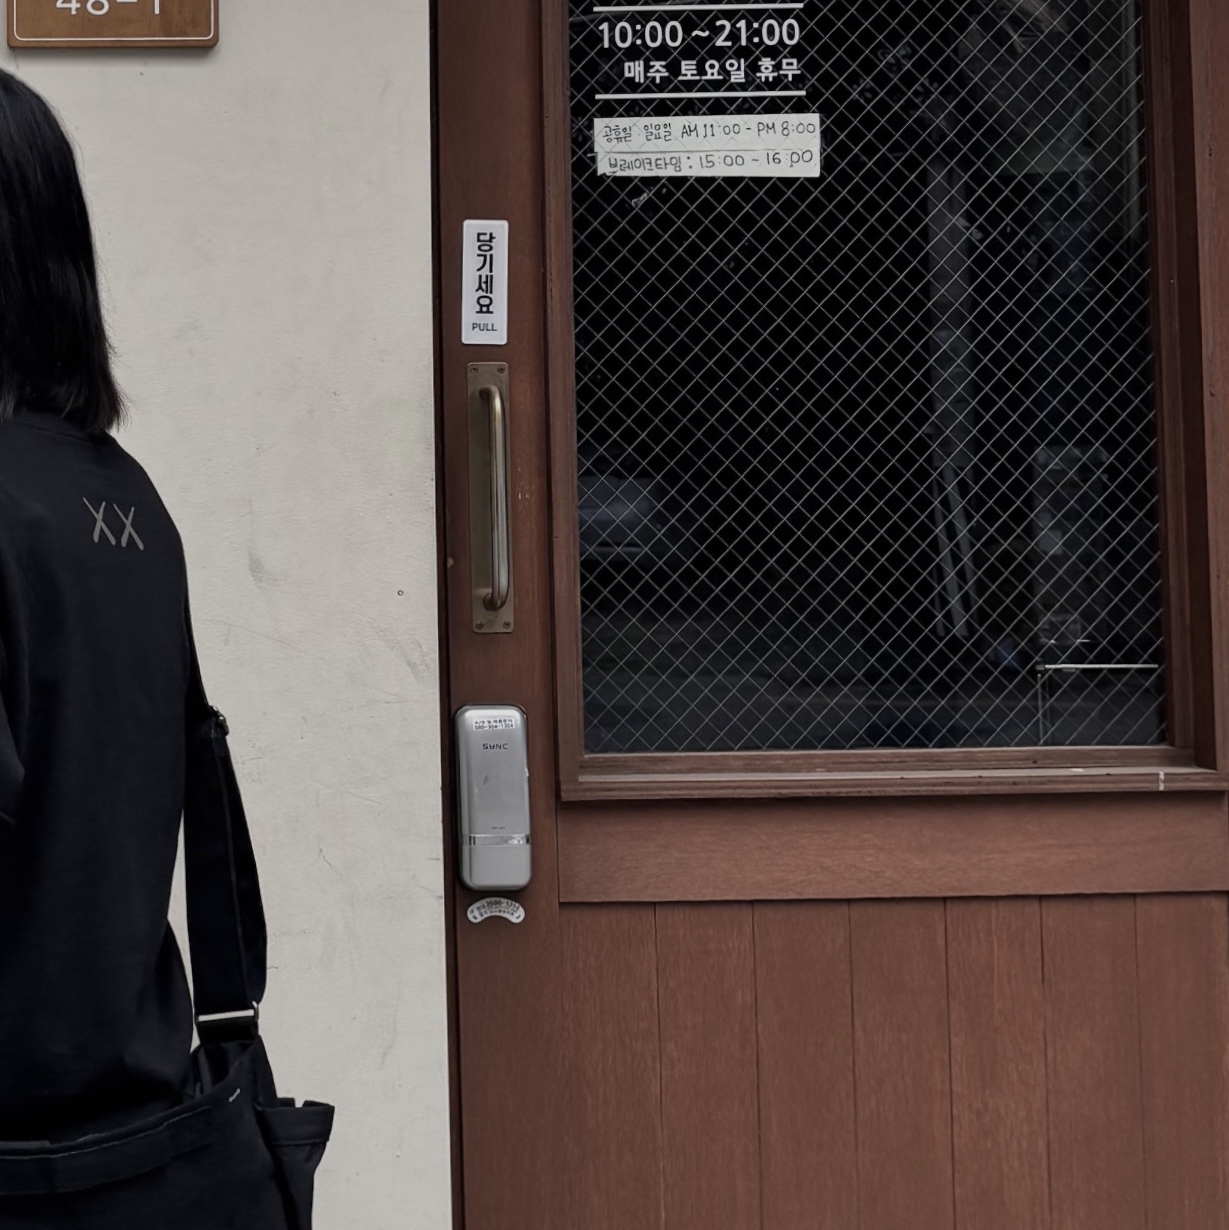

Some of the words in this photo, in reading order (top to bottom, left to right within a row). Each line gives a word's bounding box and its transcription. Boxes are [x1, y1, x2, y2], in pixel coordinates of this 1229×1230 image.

[624, 60, 669, 84] 매주
[677, 58, 746, 83] 토요일
[756, 57, 801, 82] 휴무
[643, 122, 672, 142] 일요일
[475, 232, 496, 315] 당기세요
[472, 322, 498, 332] PULL
